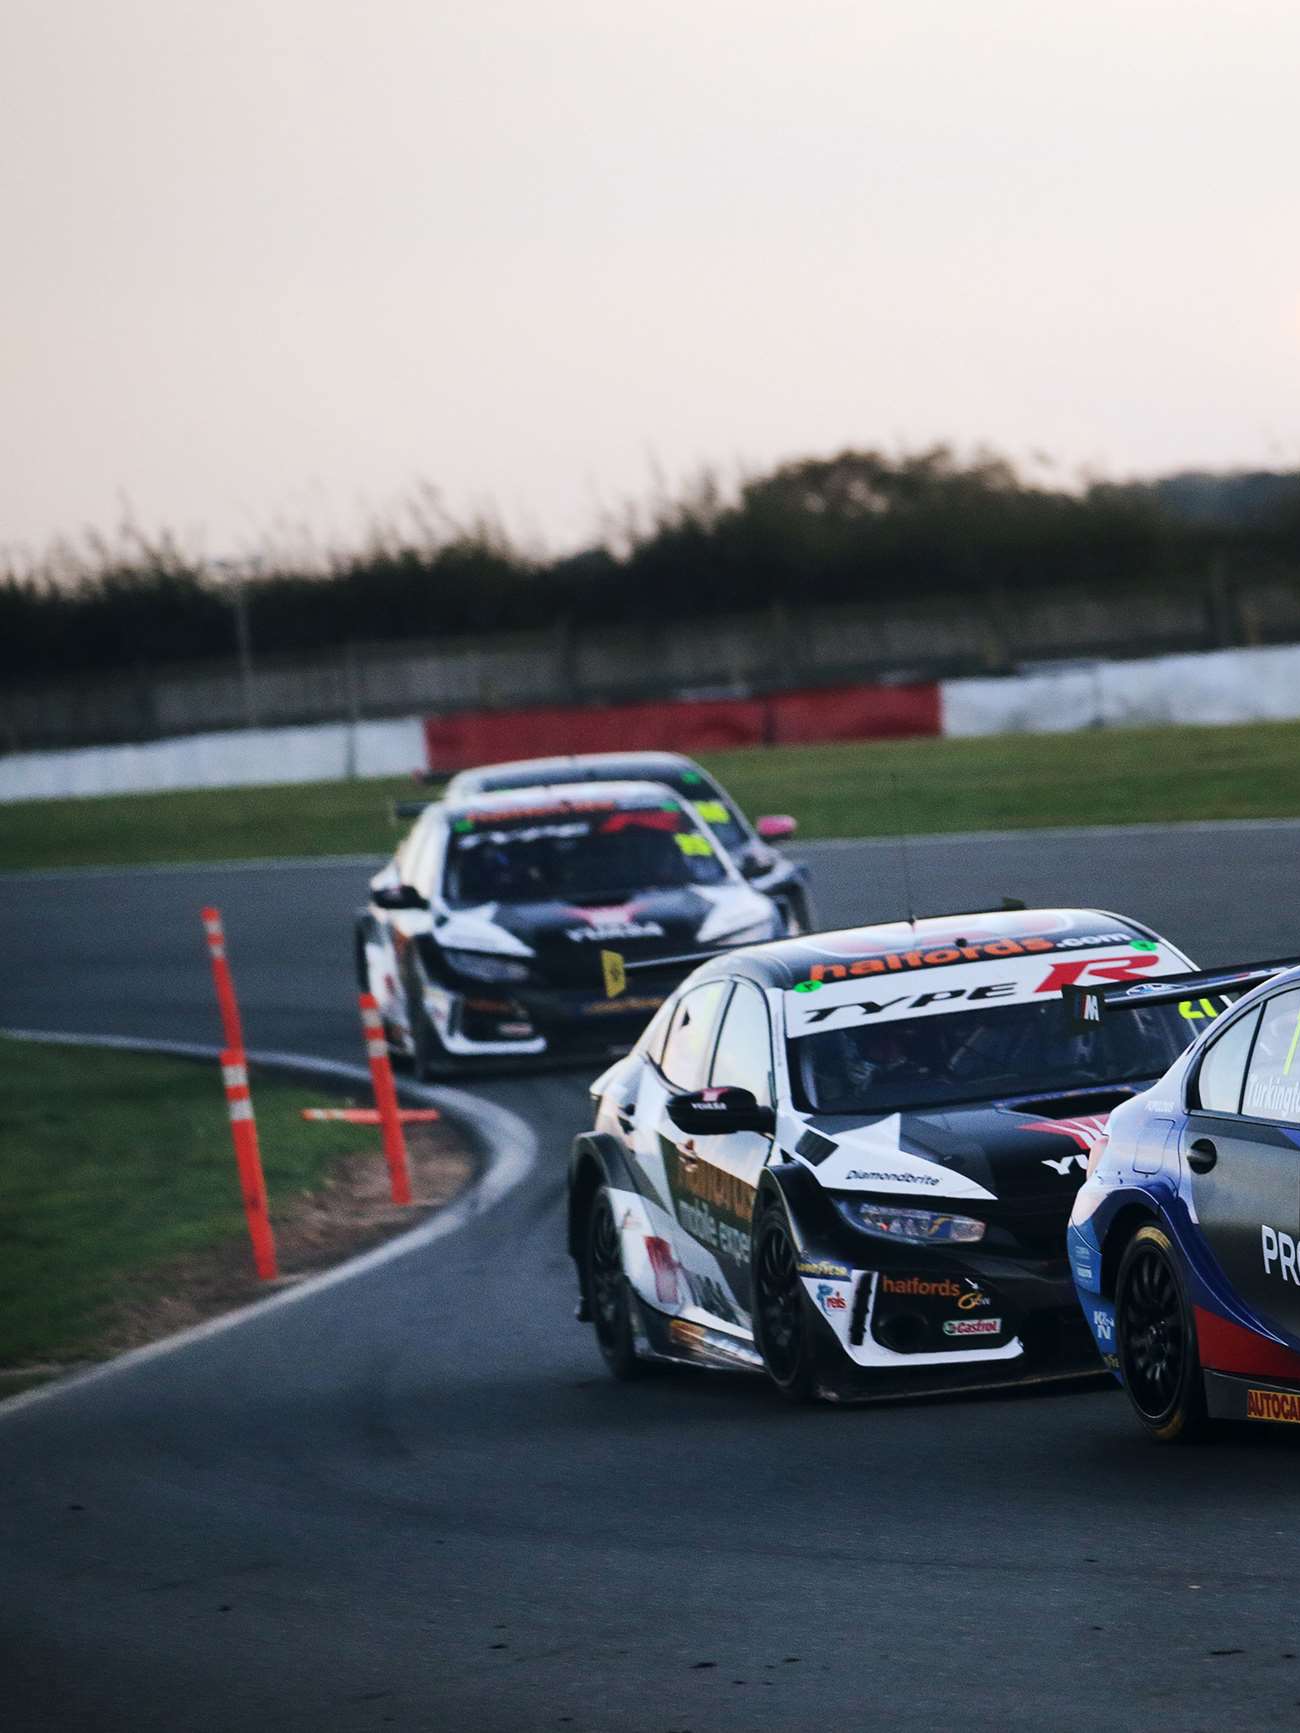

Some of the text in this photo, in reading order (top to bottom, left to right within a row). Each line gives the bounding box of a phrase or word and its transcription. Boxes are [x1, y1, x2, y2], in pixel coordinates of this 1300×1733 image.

[808, 932, 1131, 982] halfords.com
[802, 954, 1160, 1024] TYPE R
[845, 1168, 942, 1187] Diamondbrite
[883, 1275, 961, 1298] halfords
